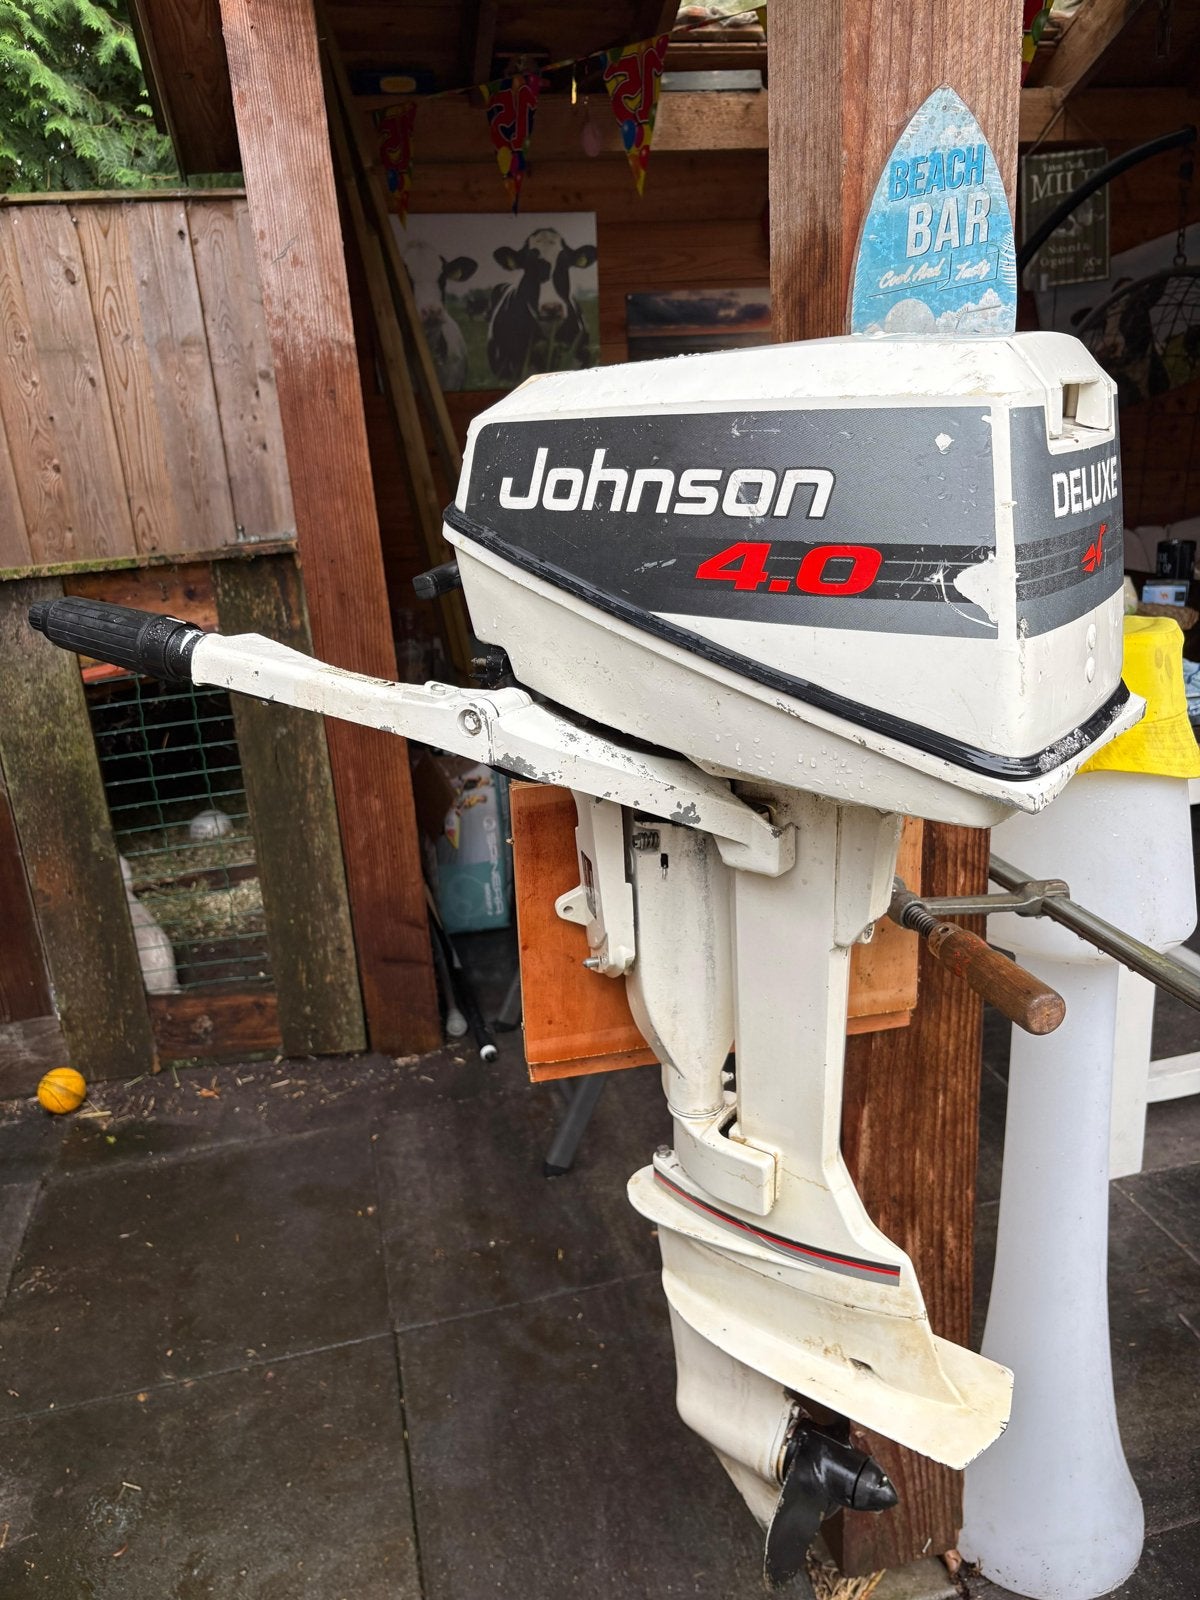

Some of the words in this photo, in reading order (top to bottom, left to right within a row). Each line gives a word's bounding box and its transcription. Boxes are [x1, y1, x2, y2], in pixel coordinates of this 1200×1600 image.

[888, 143, 987, 203] BEACH
[906, 190, 992, 259] BAR
[912, 257, 946, 282] And
[498, 446, 836, 519] Johnson
[1052, 455, 1118, 519] DELUXE
[695, 541, 883, 597] 4.0
